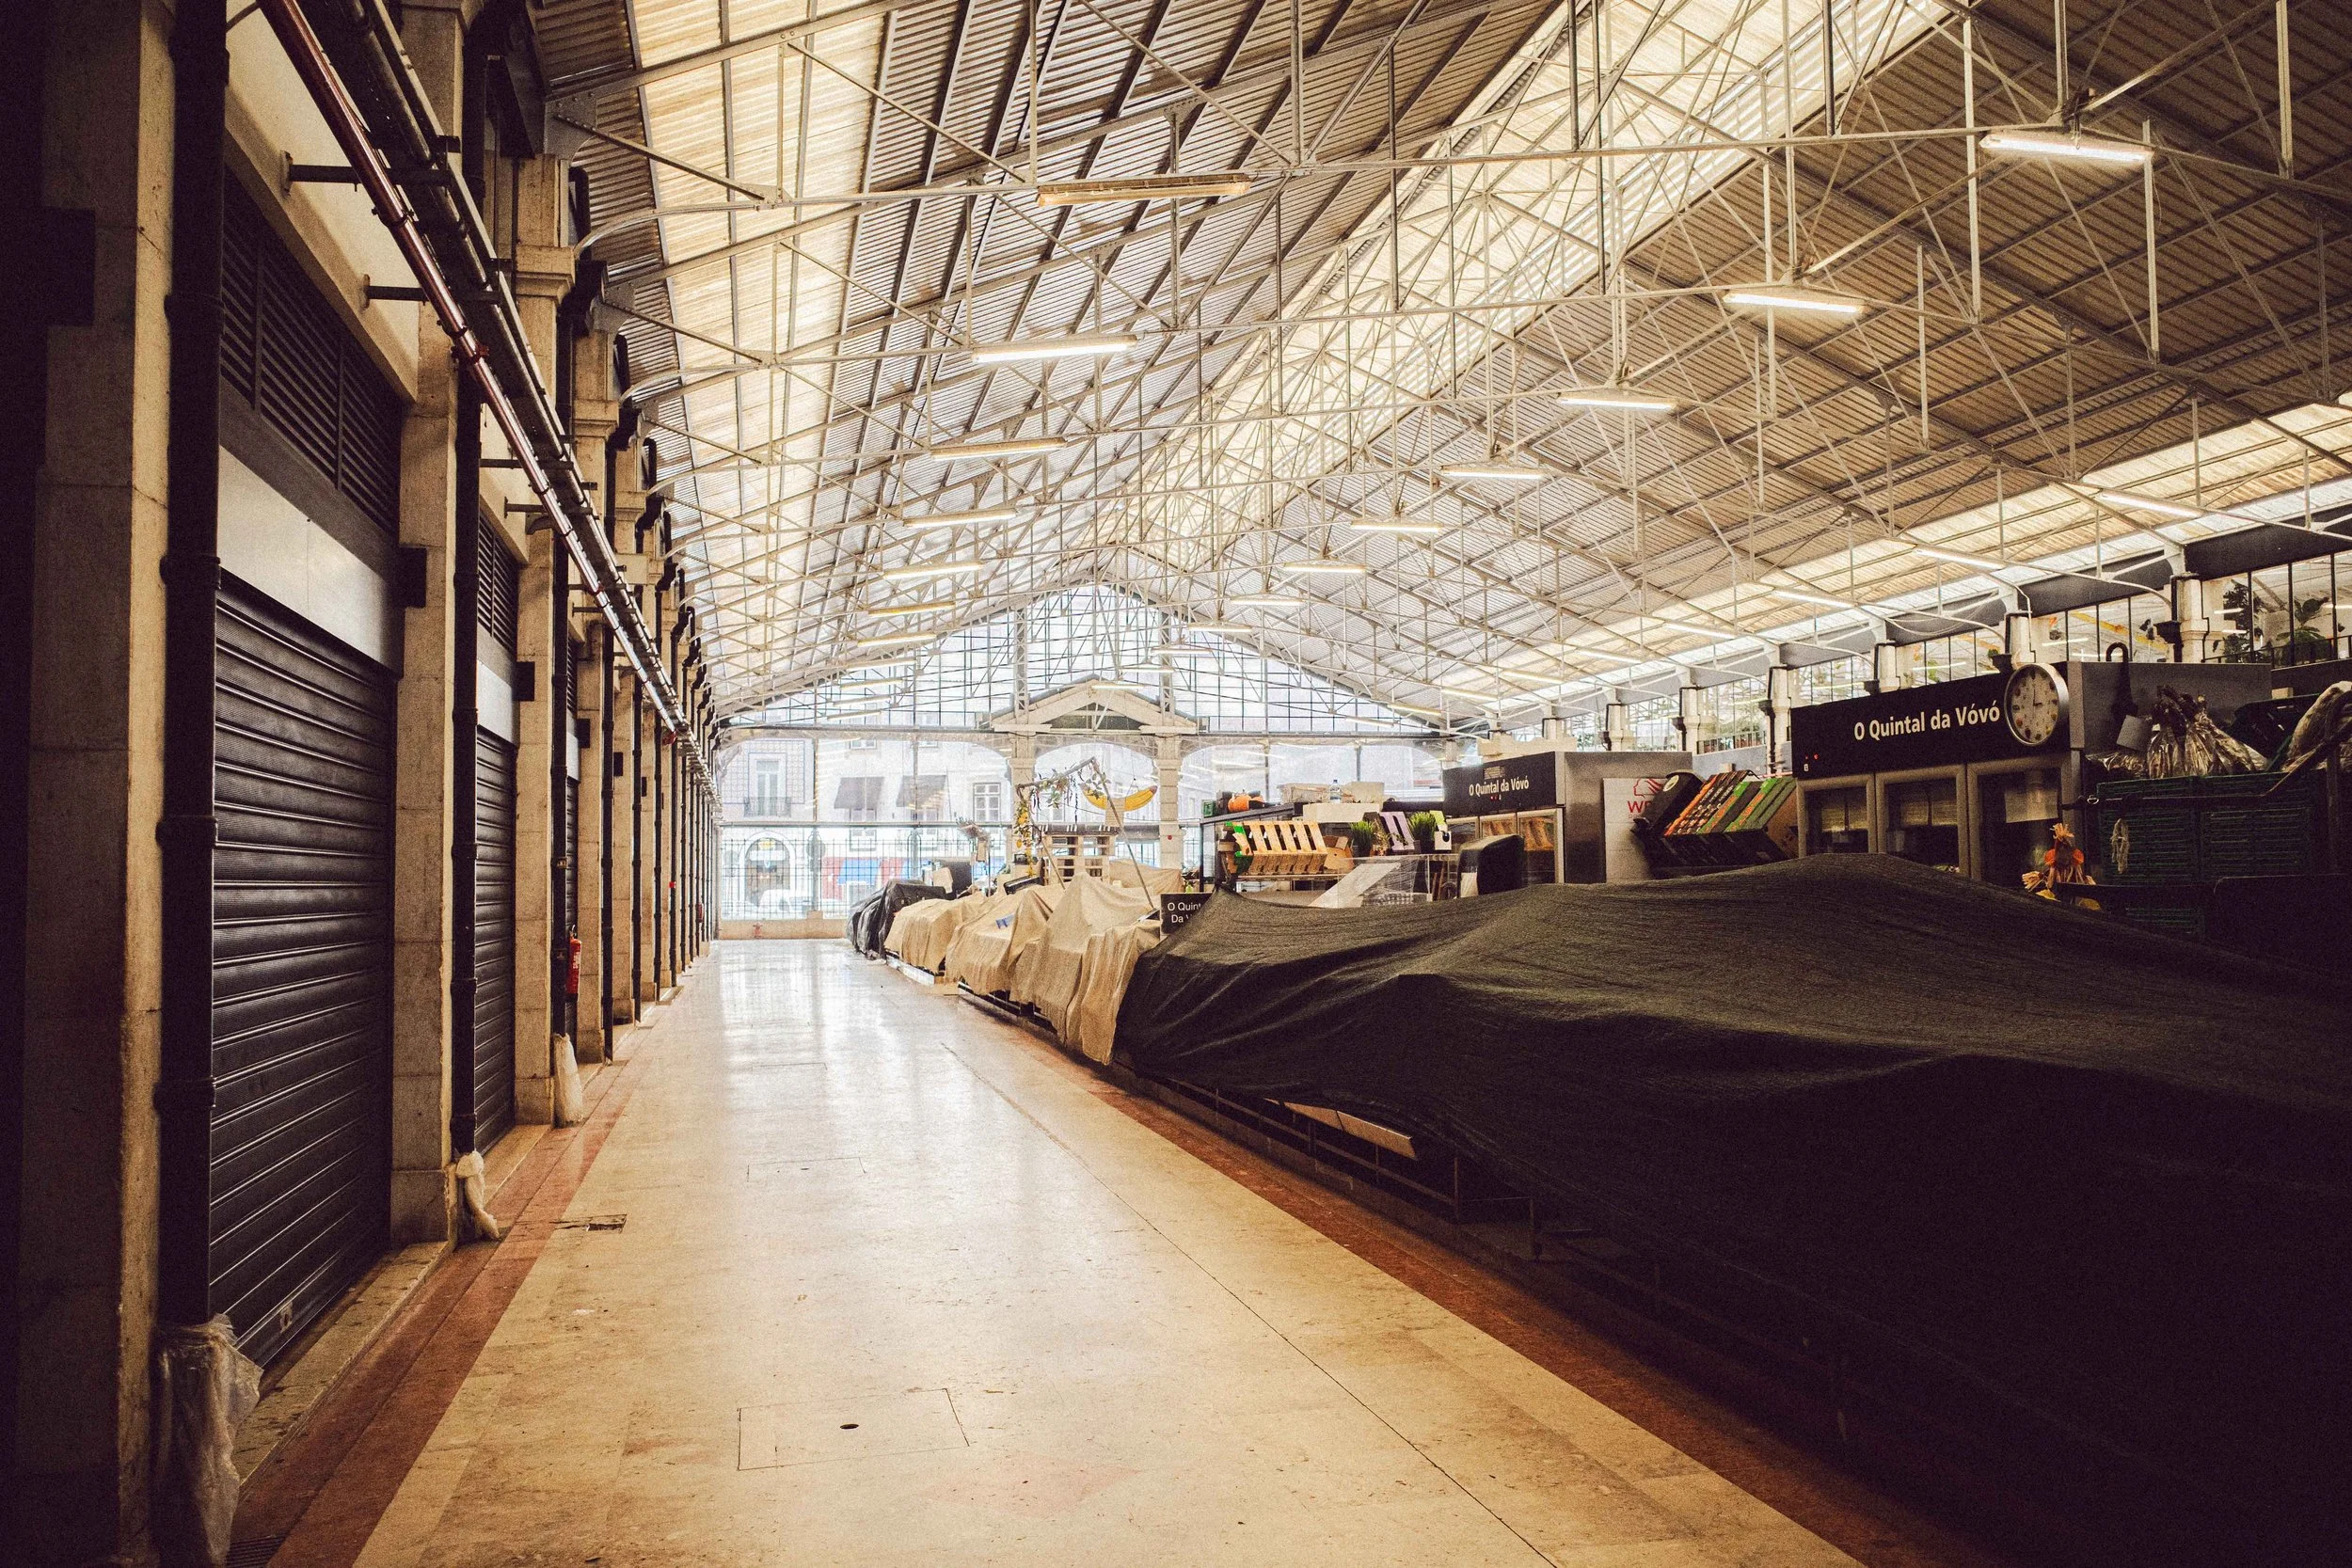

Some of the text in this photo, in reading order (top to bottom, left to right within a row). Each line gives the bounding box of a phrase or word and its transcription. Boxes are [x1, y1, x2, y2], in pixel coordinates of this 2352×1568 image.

[1853, 700, 2000, 741] O Quintal da Vóvó
[1469, 775, 1530, 797] O Quintal da Vóvó
[1167, 902, 1176, 911] O
[1171, 914, 1184, 924] Da
